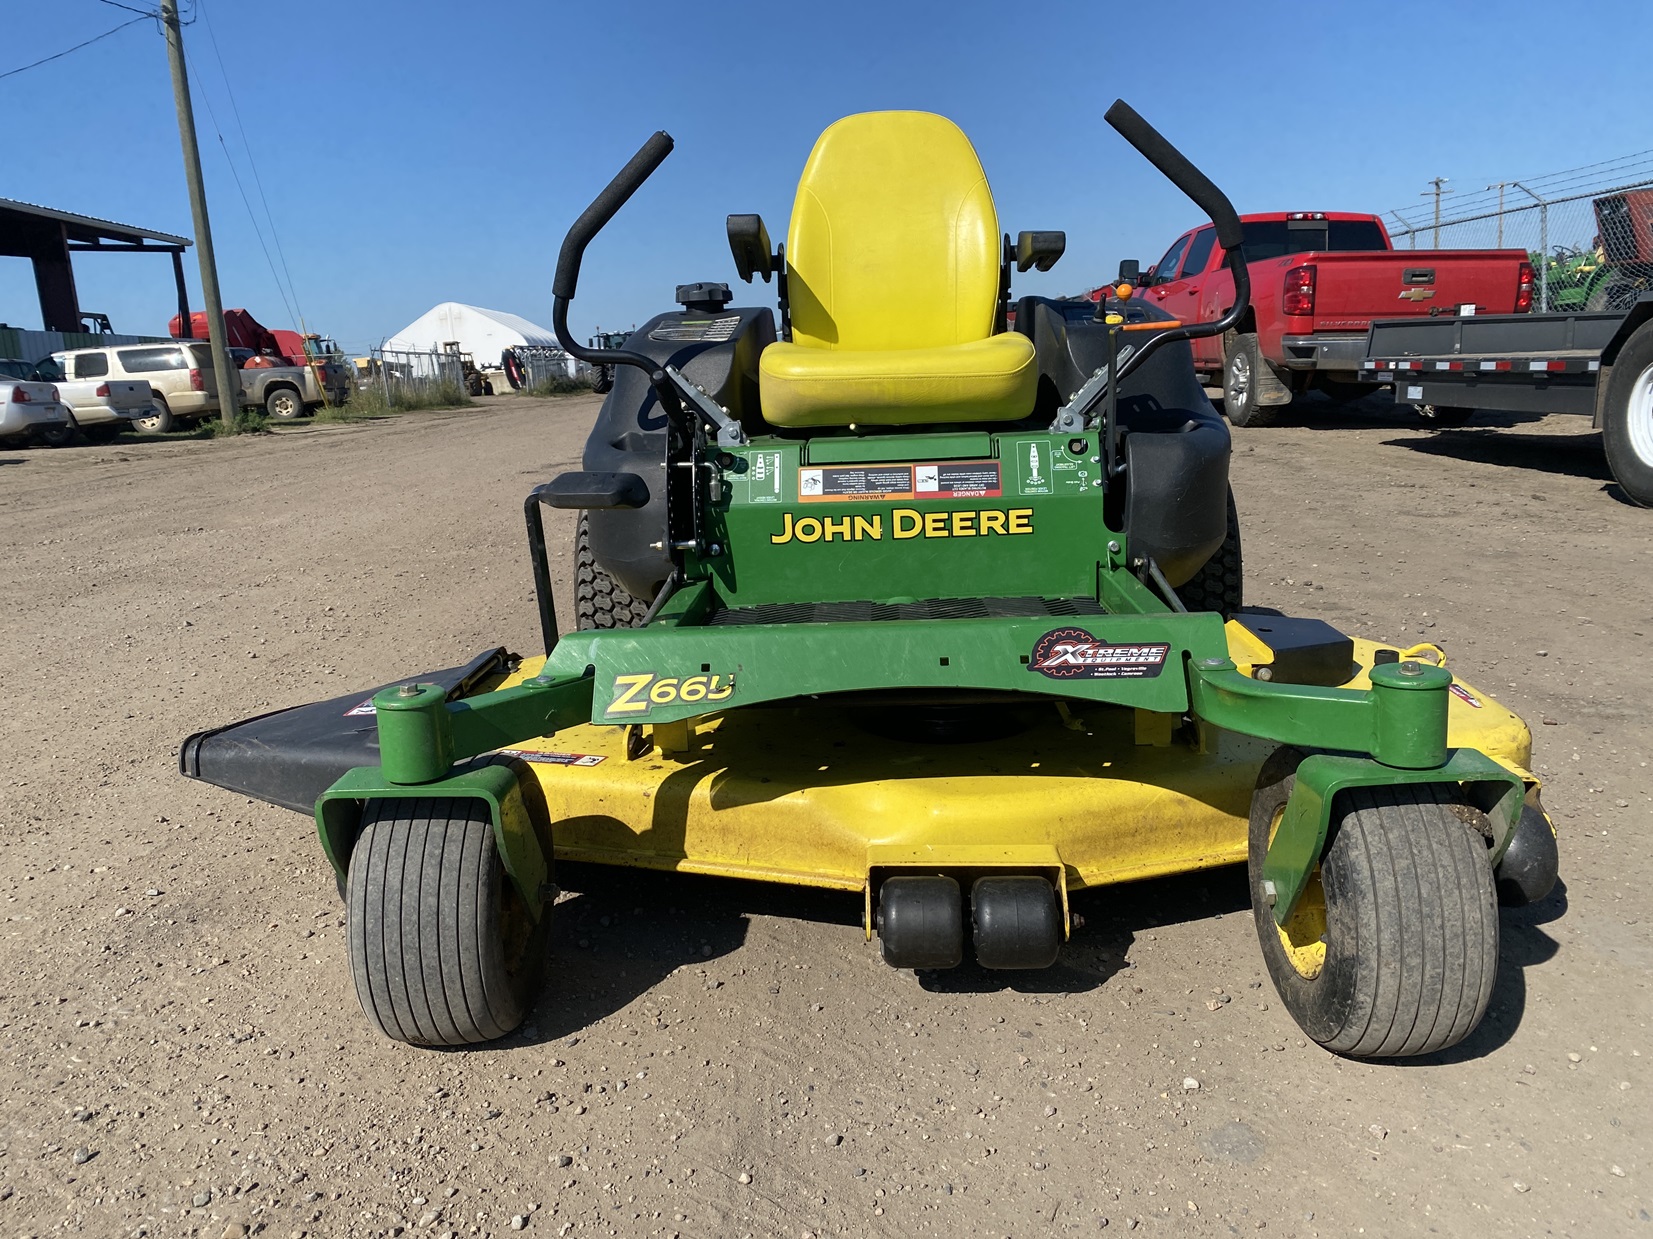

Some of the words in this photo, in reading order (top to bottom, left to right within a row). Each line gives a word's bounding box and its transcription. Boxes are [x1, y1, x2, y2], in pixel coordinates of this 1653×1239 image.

[770, 512, 882, 544] JOHN
[891, 508, 1034, 540] DEERE
[1038, 643, 1165, 667] XTREME
